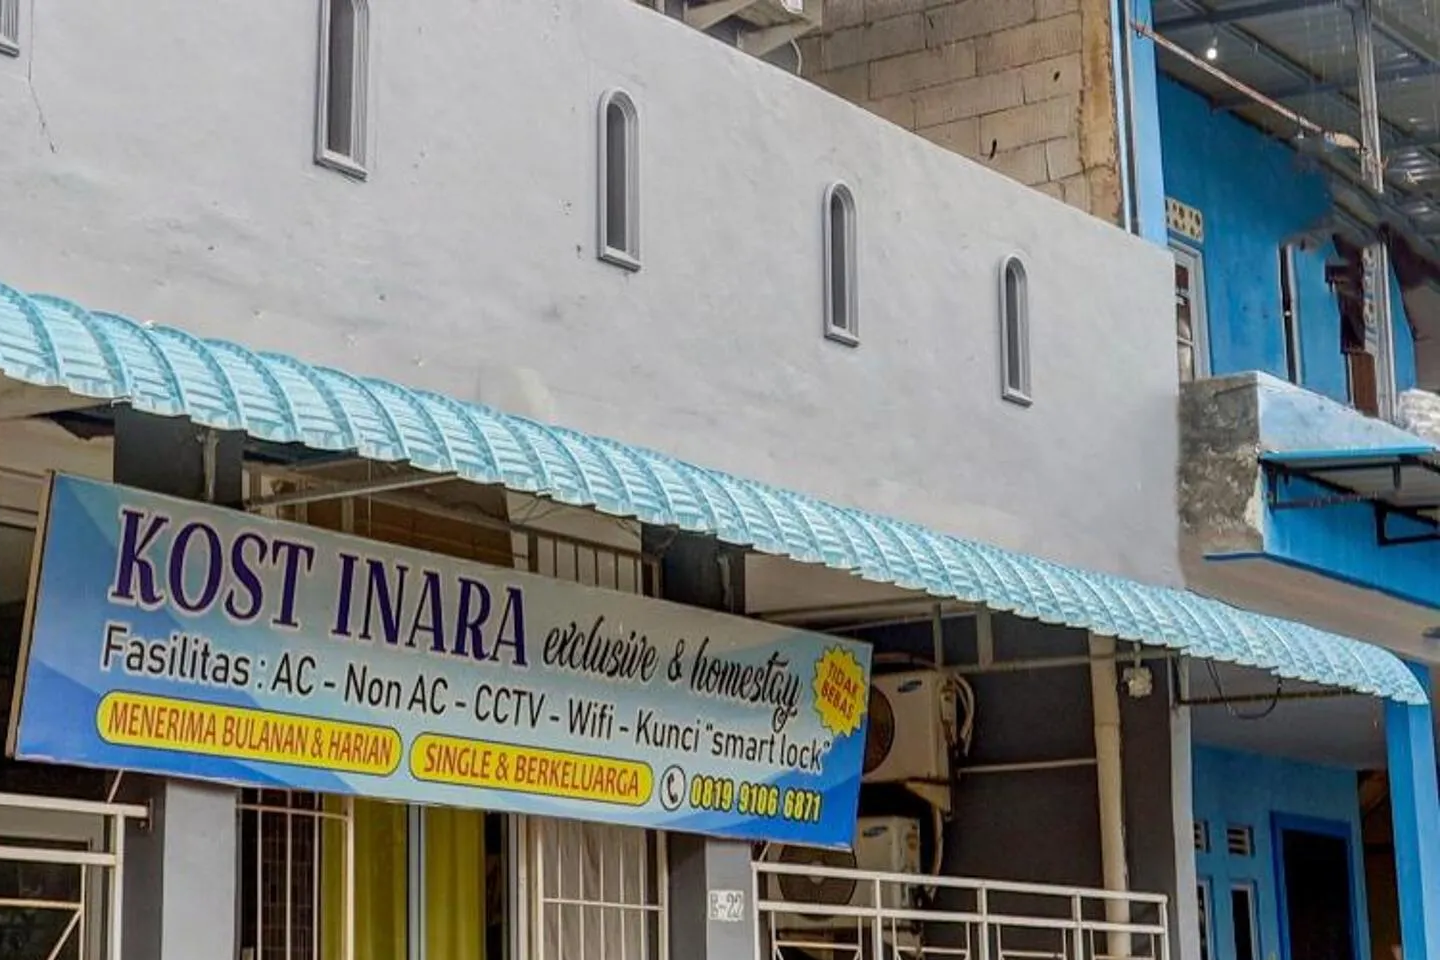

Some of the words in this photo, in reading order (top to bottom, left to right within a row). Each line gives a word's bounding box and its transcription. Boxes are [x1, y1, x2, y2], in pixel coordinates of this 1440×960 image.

[110, 509, 315, 628] KOST
[331, 552, 528, 667] INARA
[103, 623, 251, 686] Fasilitas
[271, 652, 316, 696] AC
[344, 663, 402, 709] Non
[407, 674, 449, 715] AC
[475, 684, 545, 728] CCTV
[568, 698, 614, 741] Wifi
[636, 708, 701, 753] Kunci
[543, 615, 658, 682] exclusive
[667, 638, 685, 682] &
[690, 636, 803, 733] homestay
[108, 700, 216, 745] MENERIMA
[222, 715, 310, 757] BULANAN
[312, 727, 324, 759] &
[327, 730, 394, 766] HARIAN
[424, 742, 490, 779] SINGLE
[494, 752, 509, 782] &
[514, 754, 639, 797] BERKELUARGA
[690, 773, 734, 812] 0819
[738, 780, 780, 819] 9106
[783, 787, 823, 825] 6871
